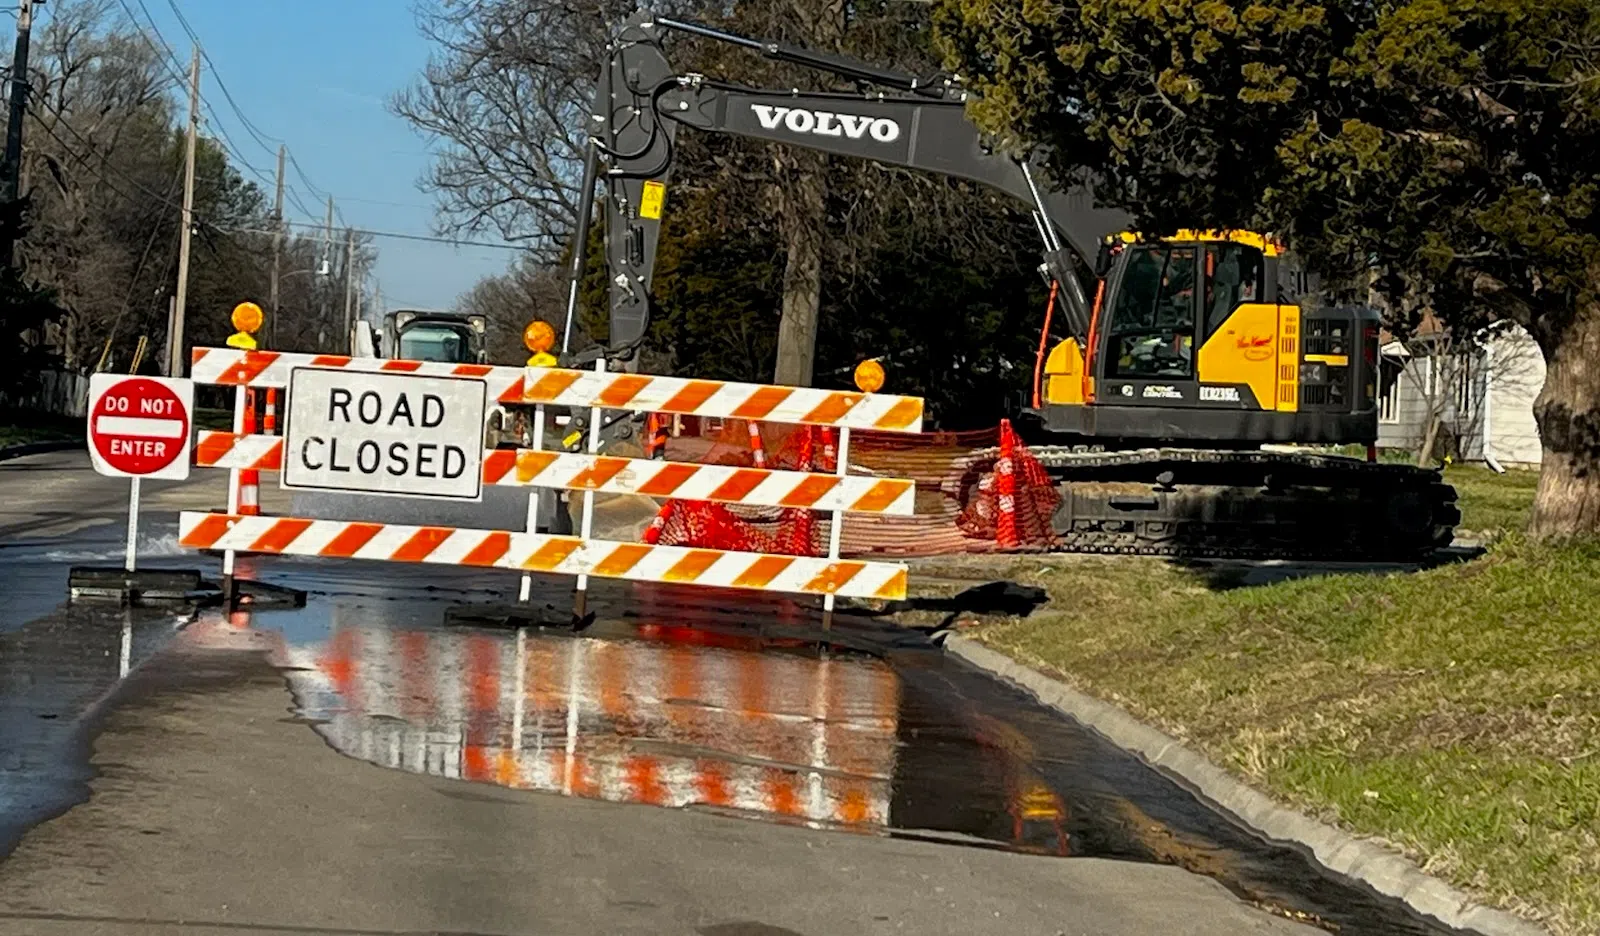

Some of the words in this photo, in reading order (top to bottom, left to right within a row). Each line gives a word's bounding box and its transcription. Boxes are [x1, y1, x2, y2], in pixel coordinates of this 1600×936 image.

[751, 104, 900, 142] VOLVO
[105, 396, 129, 412] DO
[140, 398, 175, 414] NOT
[329, 388, 445, 428] ROAD
[110, 439, 166, 457] ENTER
[301, 436, 466, 479] CLOSED
